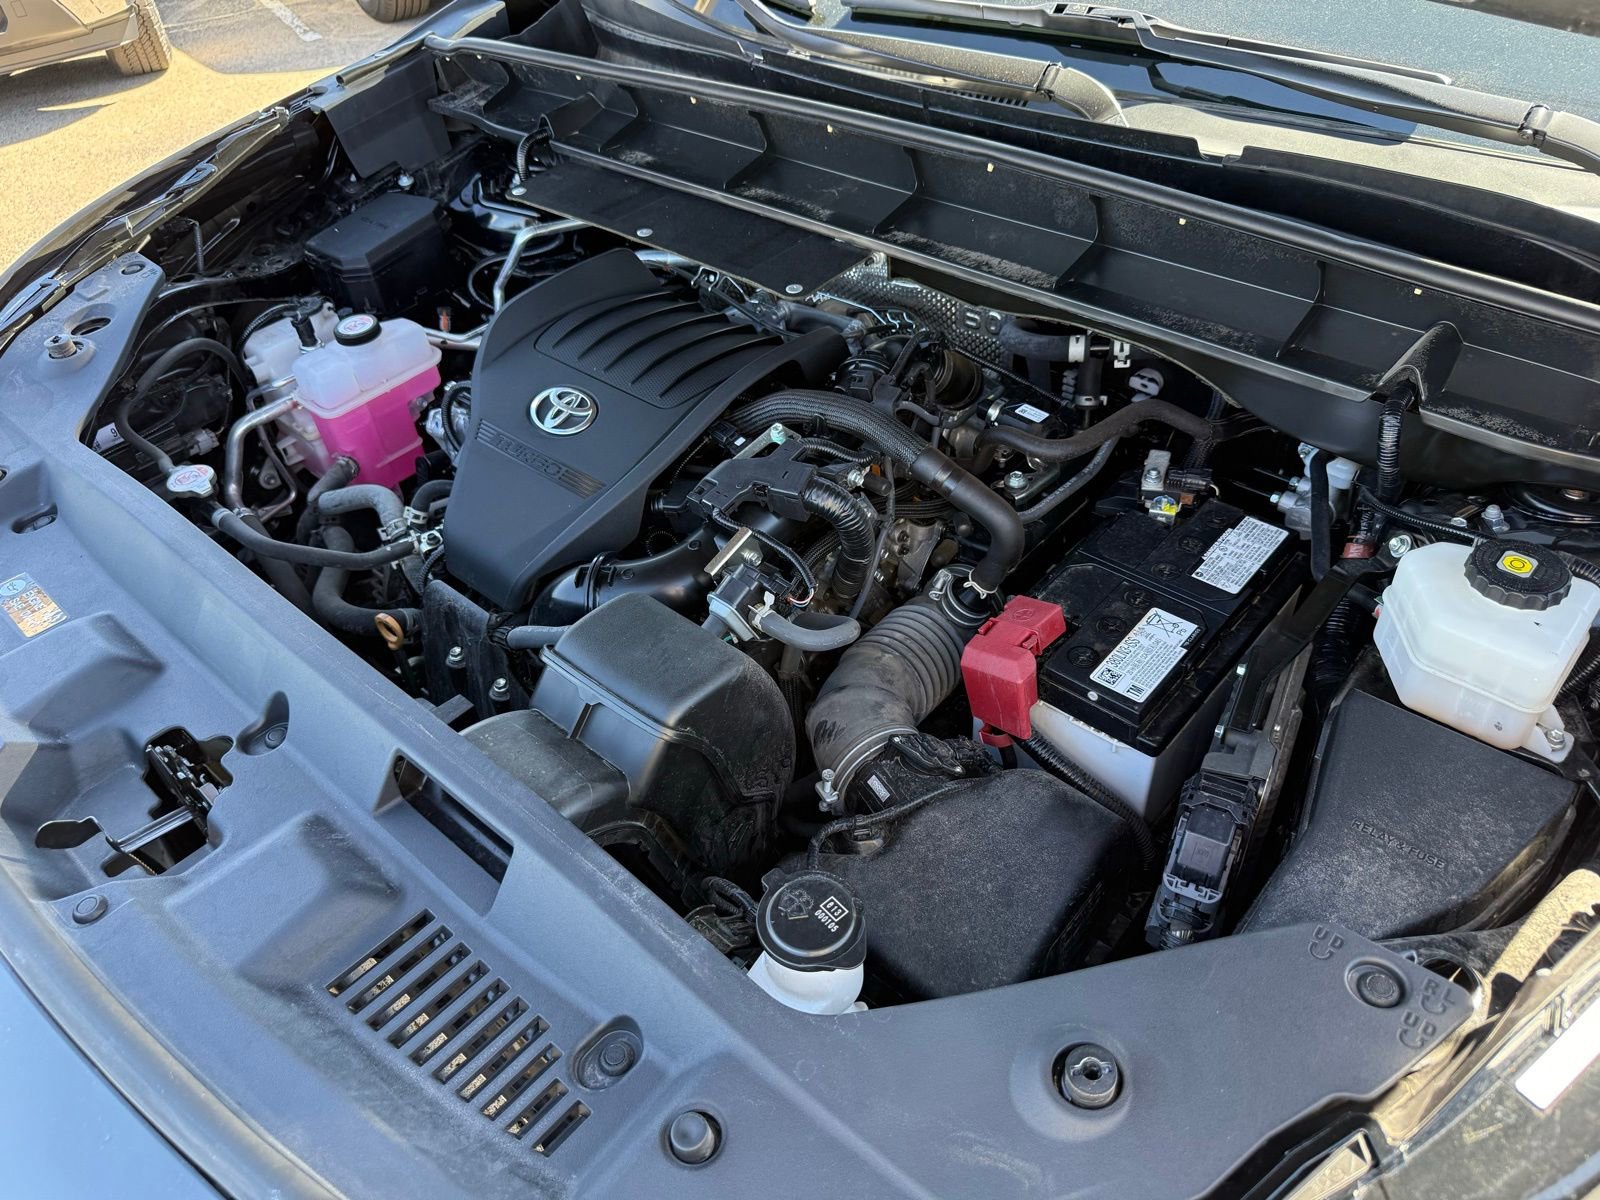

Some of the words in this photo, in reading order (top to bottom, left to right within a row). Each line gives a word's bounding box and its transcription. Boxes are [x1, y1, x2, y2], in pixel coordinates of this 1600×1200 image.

[1126, 684, 1145, 698] TM
[1352, 819, 1395, 844] RELAY
[1396, 841, 1406, 851] &
[1408, 847, 1446, 869] FUSE
[814, 909, 839, 932] 000105
